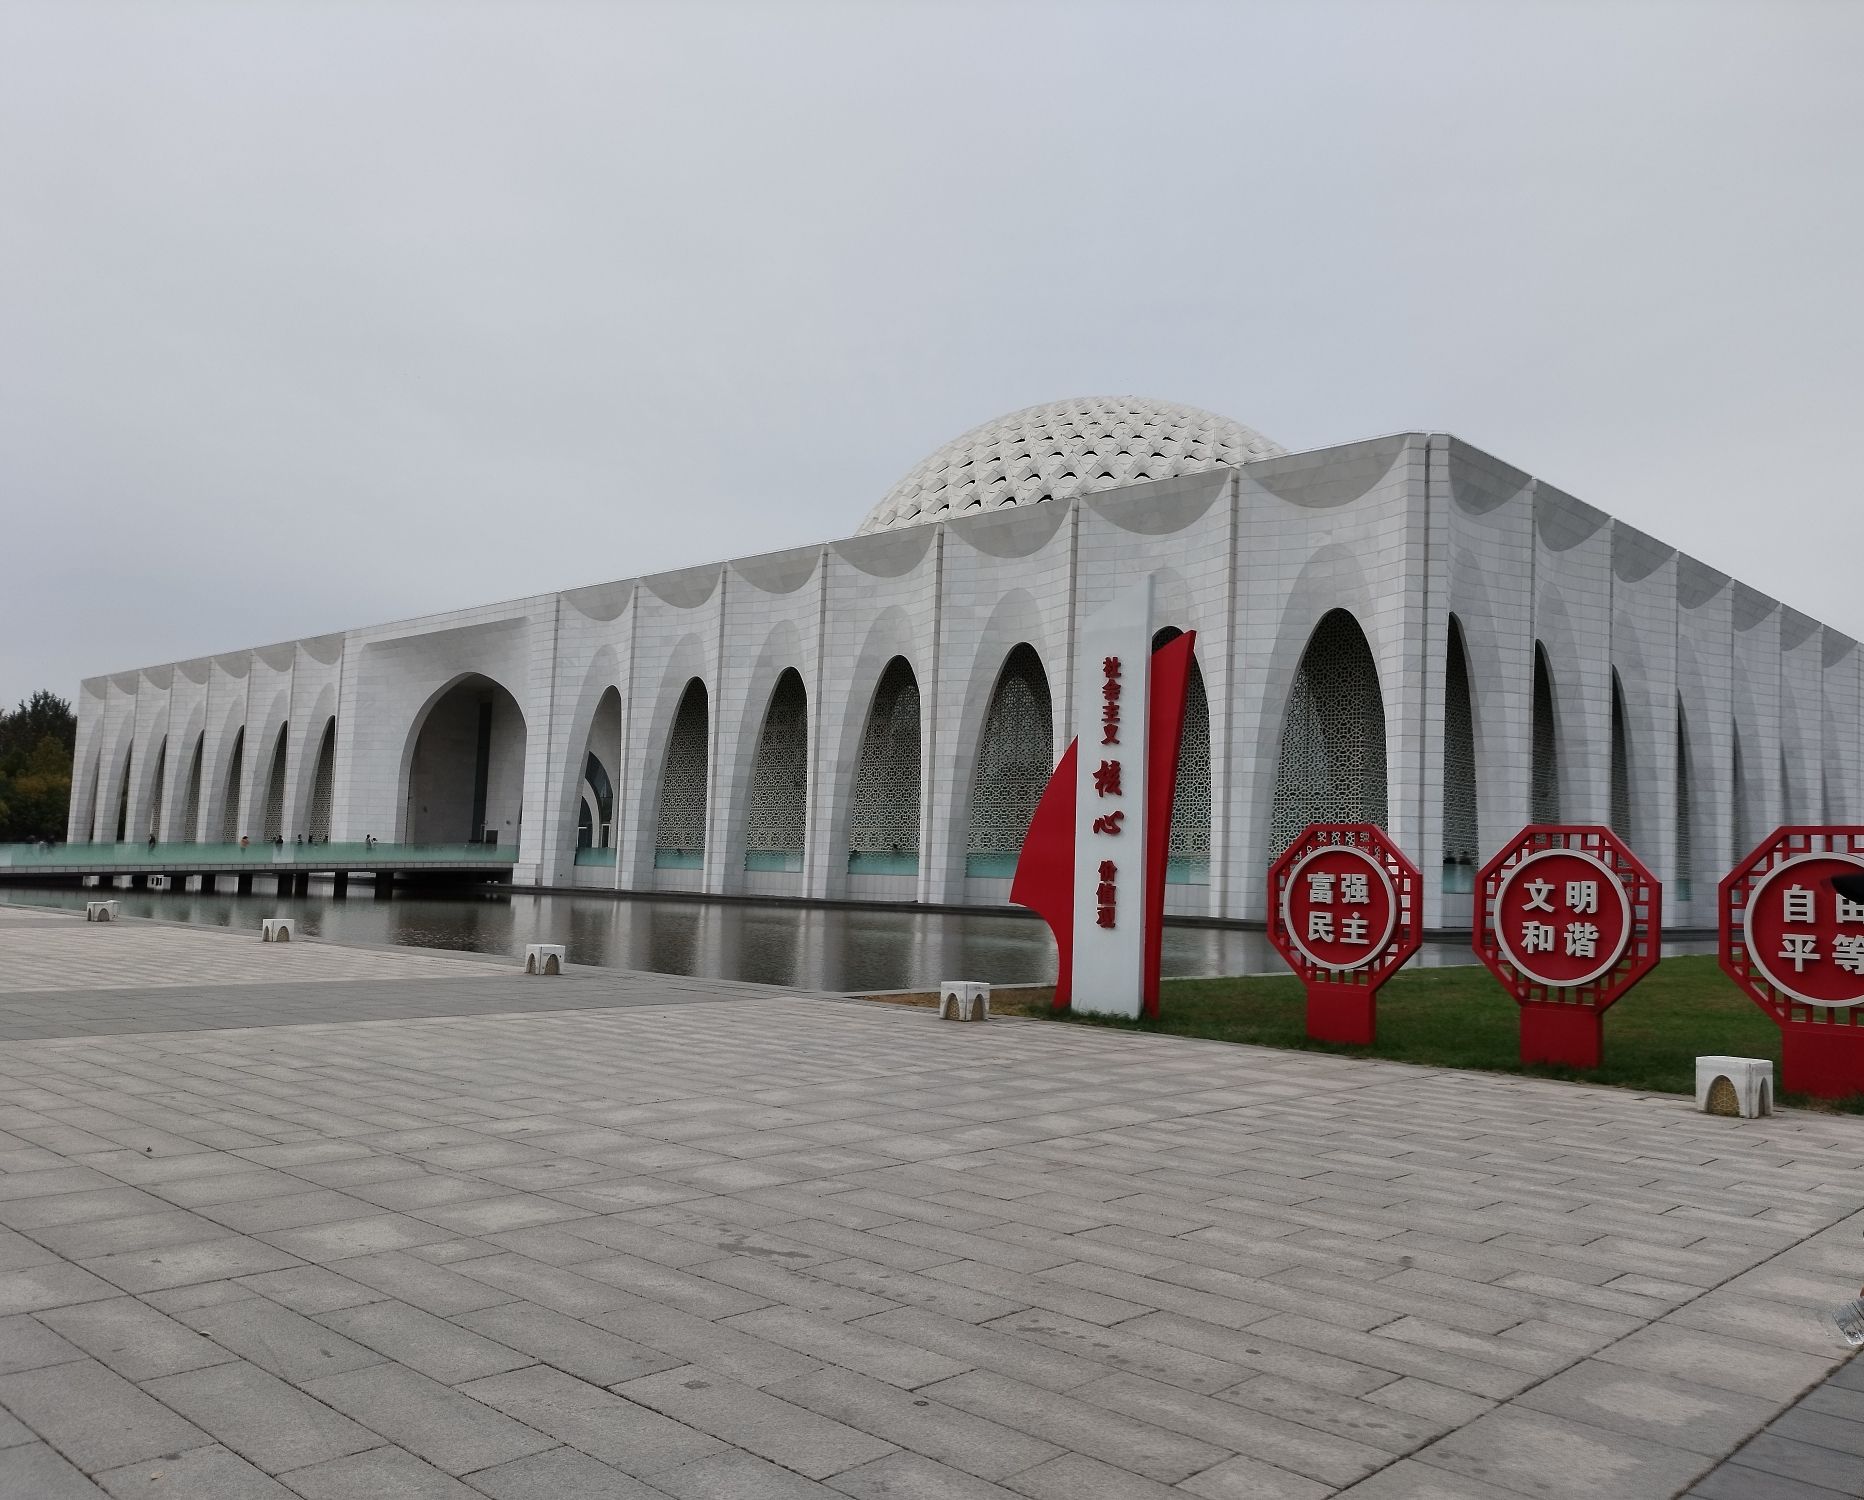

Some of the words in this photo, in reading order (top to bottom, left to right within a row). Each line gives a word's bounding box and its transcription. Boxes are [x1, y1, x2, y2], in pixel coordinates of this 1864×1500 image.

[1092, 656, 1124, 929] 社会主义核心价值观
[1307, 872, 1370, 904] 富强
[1522, 878, 1598, 914] 文明
[1307, 911, 1370, 944] 民主
[1520, 921, 1600, 958] 和谐
[1778, 934, 1864, 975] 平等
